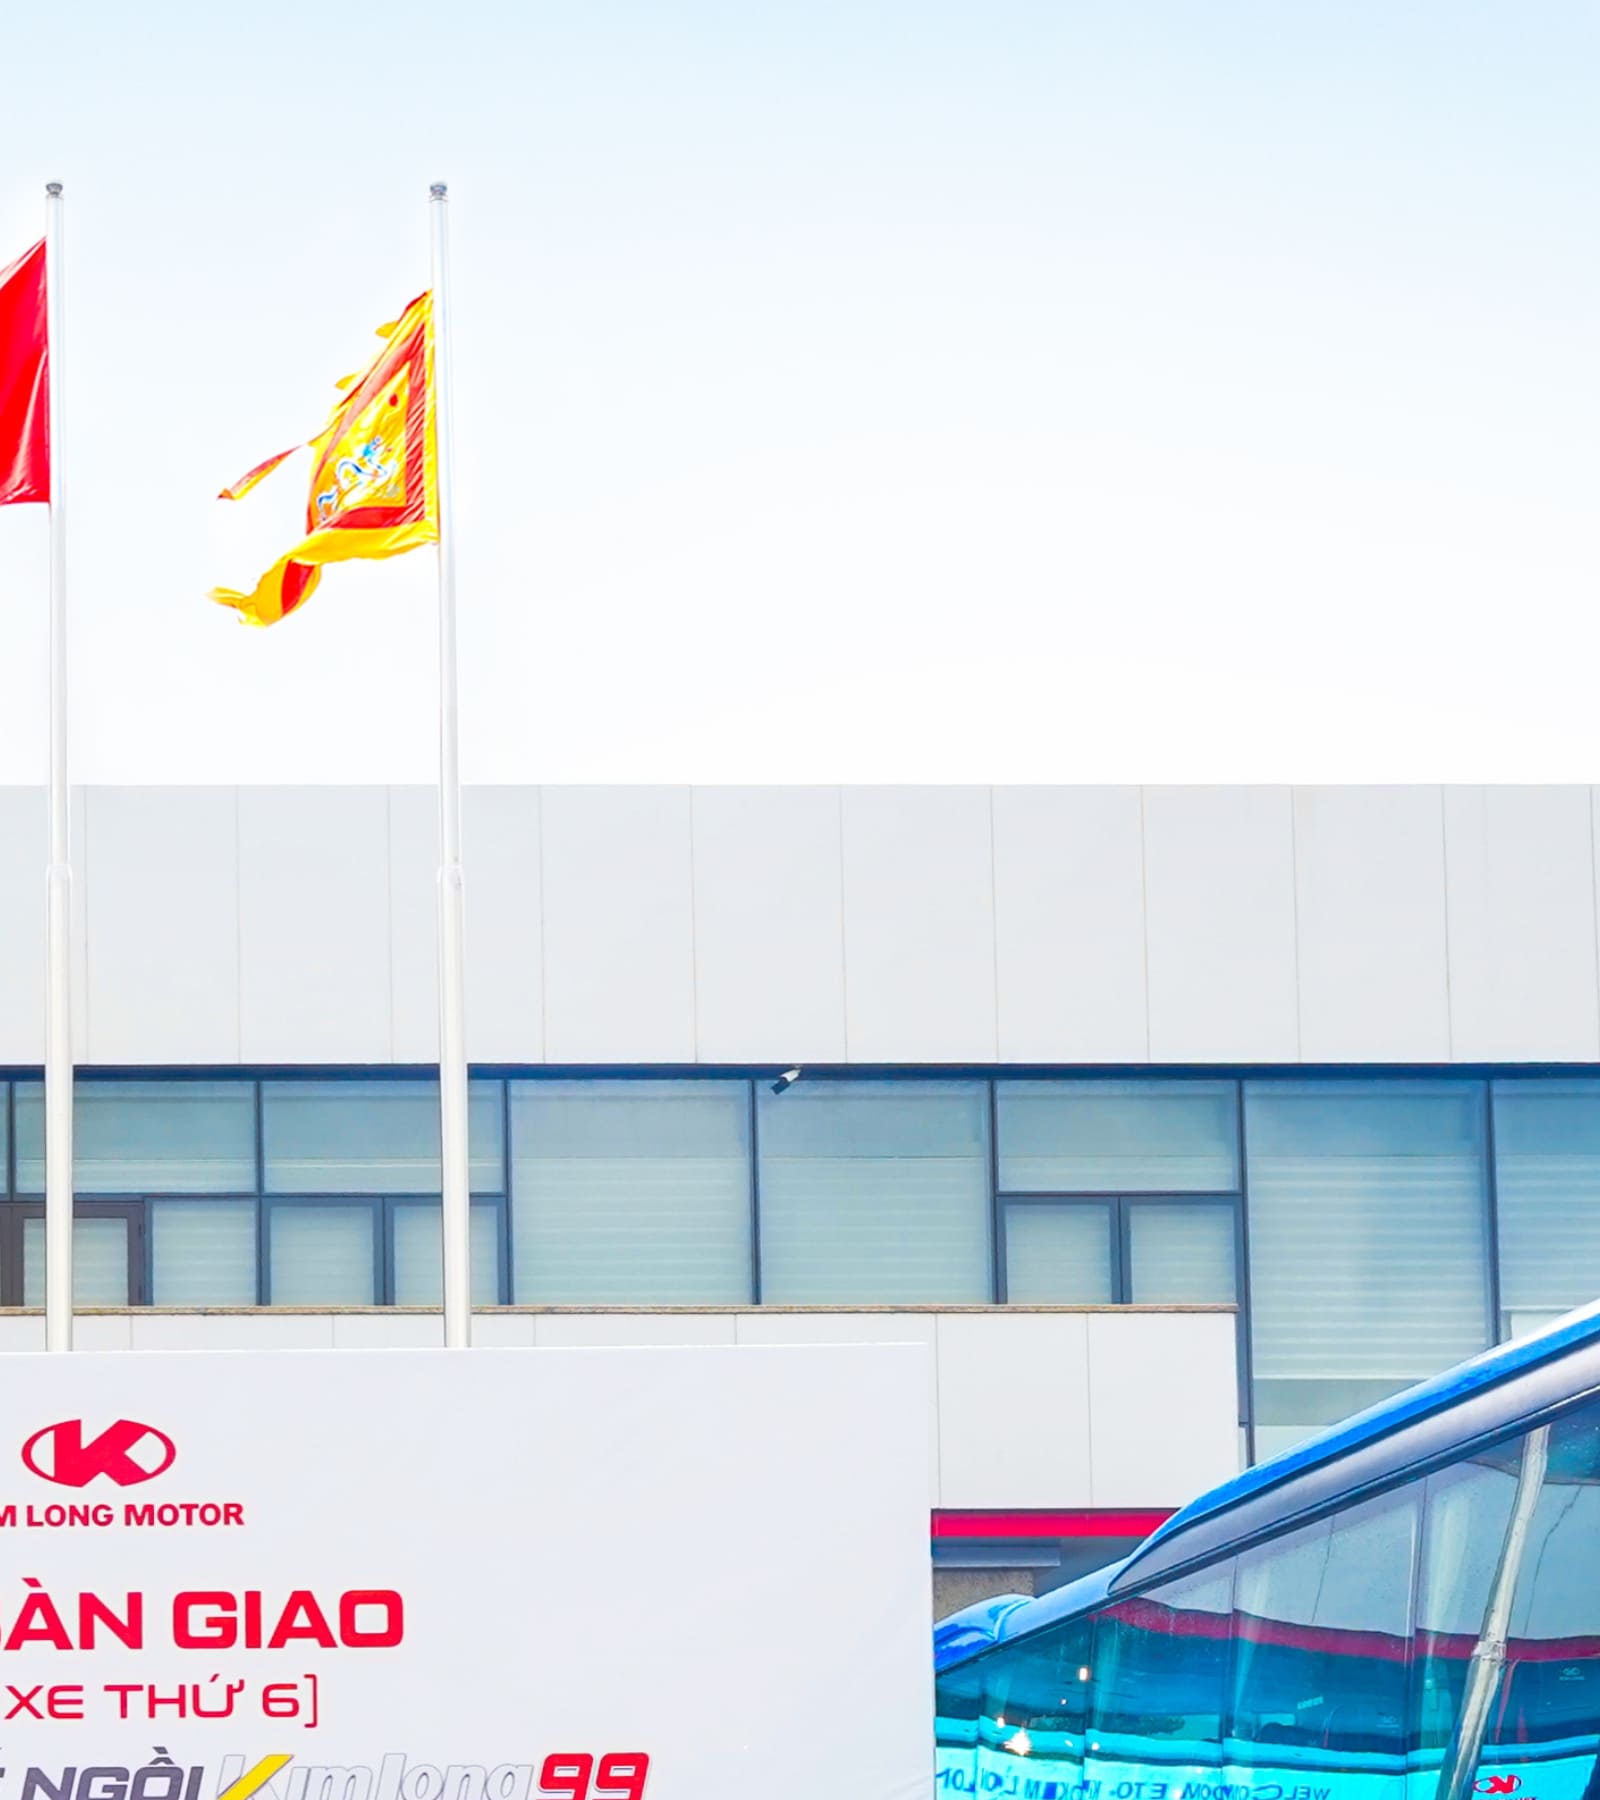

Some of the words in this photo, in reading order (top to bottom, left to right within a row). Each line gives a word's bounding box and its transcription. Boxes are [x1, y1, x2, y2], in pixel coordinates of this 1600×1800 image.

[26, 1503, 114, 1527] LONG
[124, 1502, 245, 1527] MOTOR
[172, 1589, 405, 1650] GIAO
[5, 1684, 85, 1720] XE
[103, 1674, 246, 1719] THỨ
